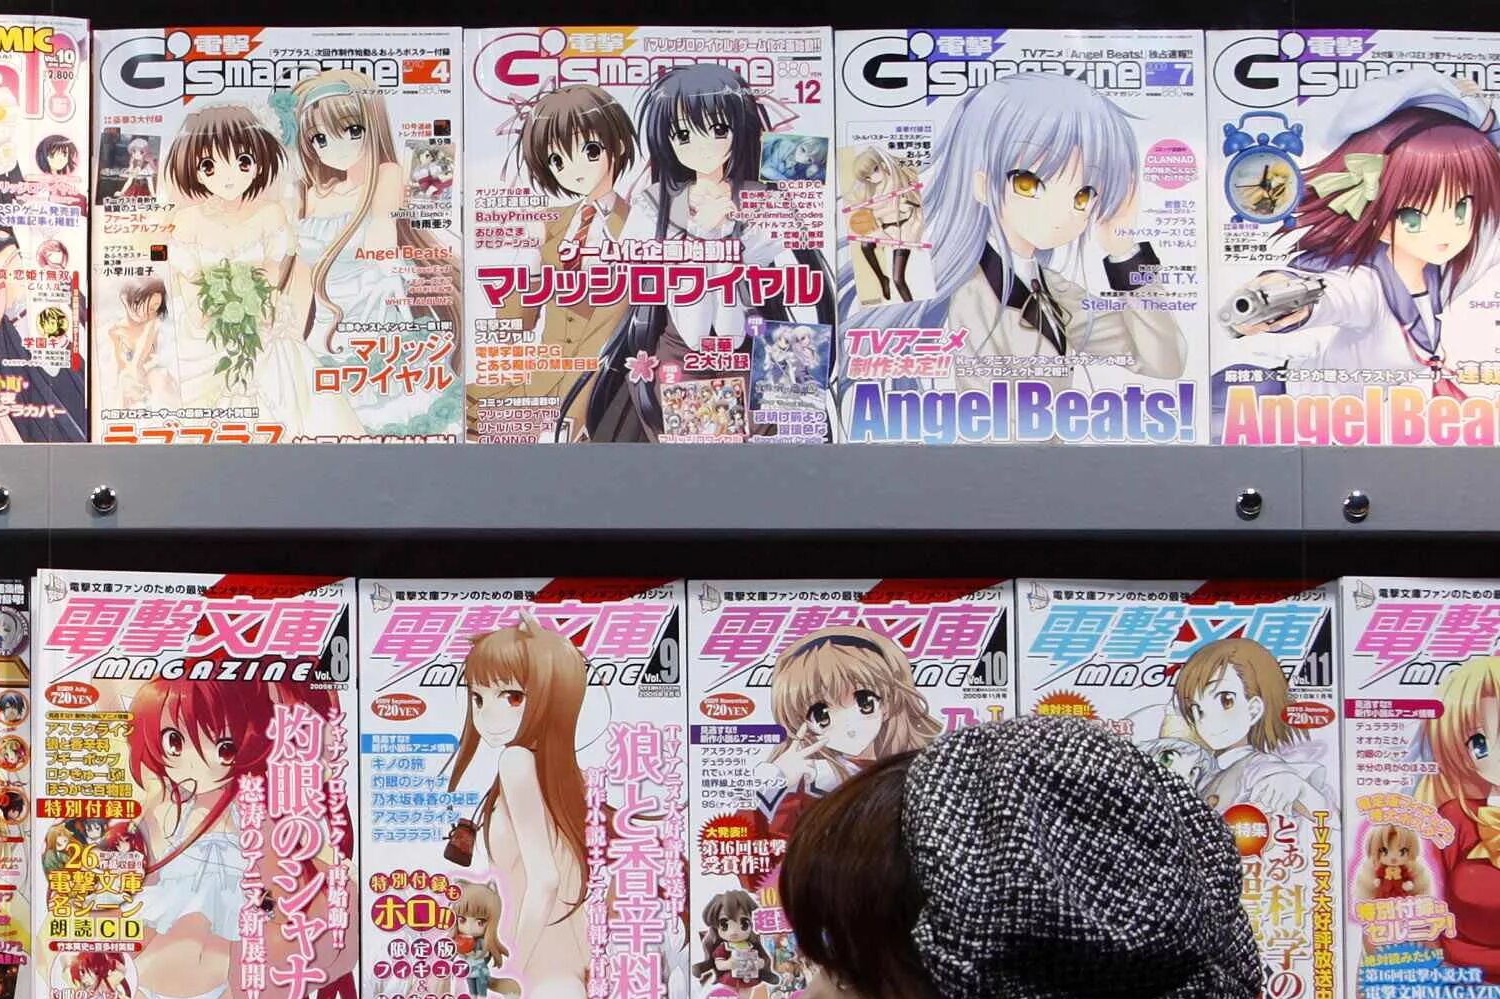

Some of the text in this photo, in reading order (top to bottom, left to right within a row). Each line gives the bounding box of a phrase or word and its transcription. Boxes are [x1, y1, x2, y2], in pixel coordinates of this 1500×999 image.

[194, 34, 249, 56] 電撃
[936, 35, 992, 56] 電撃
[1307, 36, 1362, 56] 電撃
[1174, 64, 1191, 85] 7
[794, 81, 820, 104] 12
[1147, 155, 1194, 164] CLANNAD
[104, 214, 147, 222] ファースト
[475, 210, 559, 223] BabyPrincess
[104, 223, 176, 234] ビジュアルブック
[355, 246, 453, 261] Angel Beats!
[558, 240, 741, 264] ゲーム化企画始動!!
[1224, 253, 1288, 262] アラームクロック
[477, 264, 824, 307] マリッジロワイヤル
[350, 334, 452, 362] マリッジ
[846, 328, 969, 354] TVアニメ
[684, 353, 749, 370] 2大付録
[847, 354, 952, 378] 制作決定!!
[315, 366, 453, 394] ロワイヤル
[475, 372, 532, 385] とらドラ!
[849, 380, 1197, 444] Angel Beats!
[1224, 386, 1500, 446] Angel Bea
[45, 597, 340, 670] 電撃文庫
[1029, 603, 1320, 680] 電撃文庫
[94, 658, 317, 681] MAGAZINE
[706, 703, 749, 716] 720YEN
[1287, 712, 1329, 725] 720YEN
[45, 722, 134, 737] アスラクライン
[1356, 736, 1408, 745] オオカミさん
[701, 747, 761, 756] アスラクライン
[372, 758, 425, 770] キノの旅
[1356, 764, 1437, 772] 半分の月がのぼる空
[372, 775, 448, 789] 灼眼のシャナ
[372, 792, 479, 805] 乃木坂春香の秘密
[44, 801, 135, 818] 特別付録!!
[68, 844, 99, 868] 26
[50, 871, 143, 894] 電撃文庫
[50, 895, 144, 917] 名シーン
[389, 938, 456, 958] 限定版
